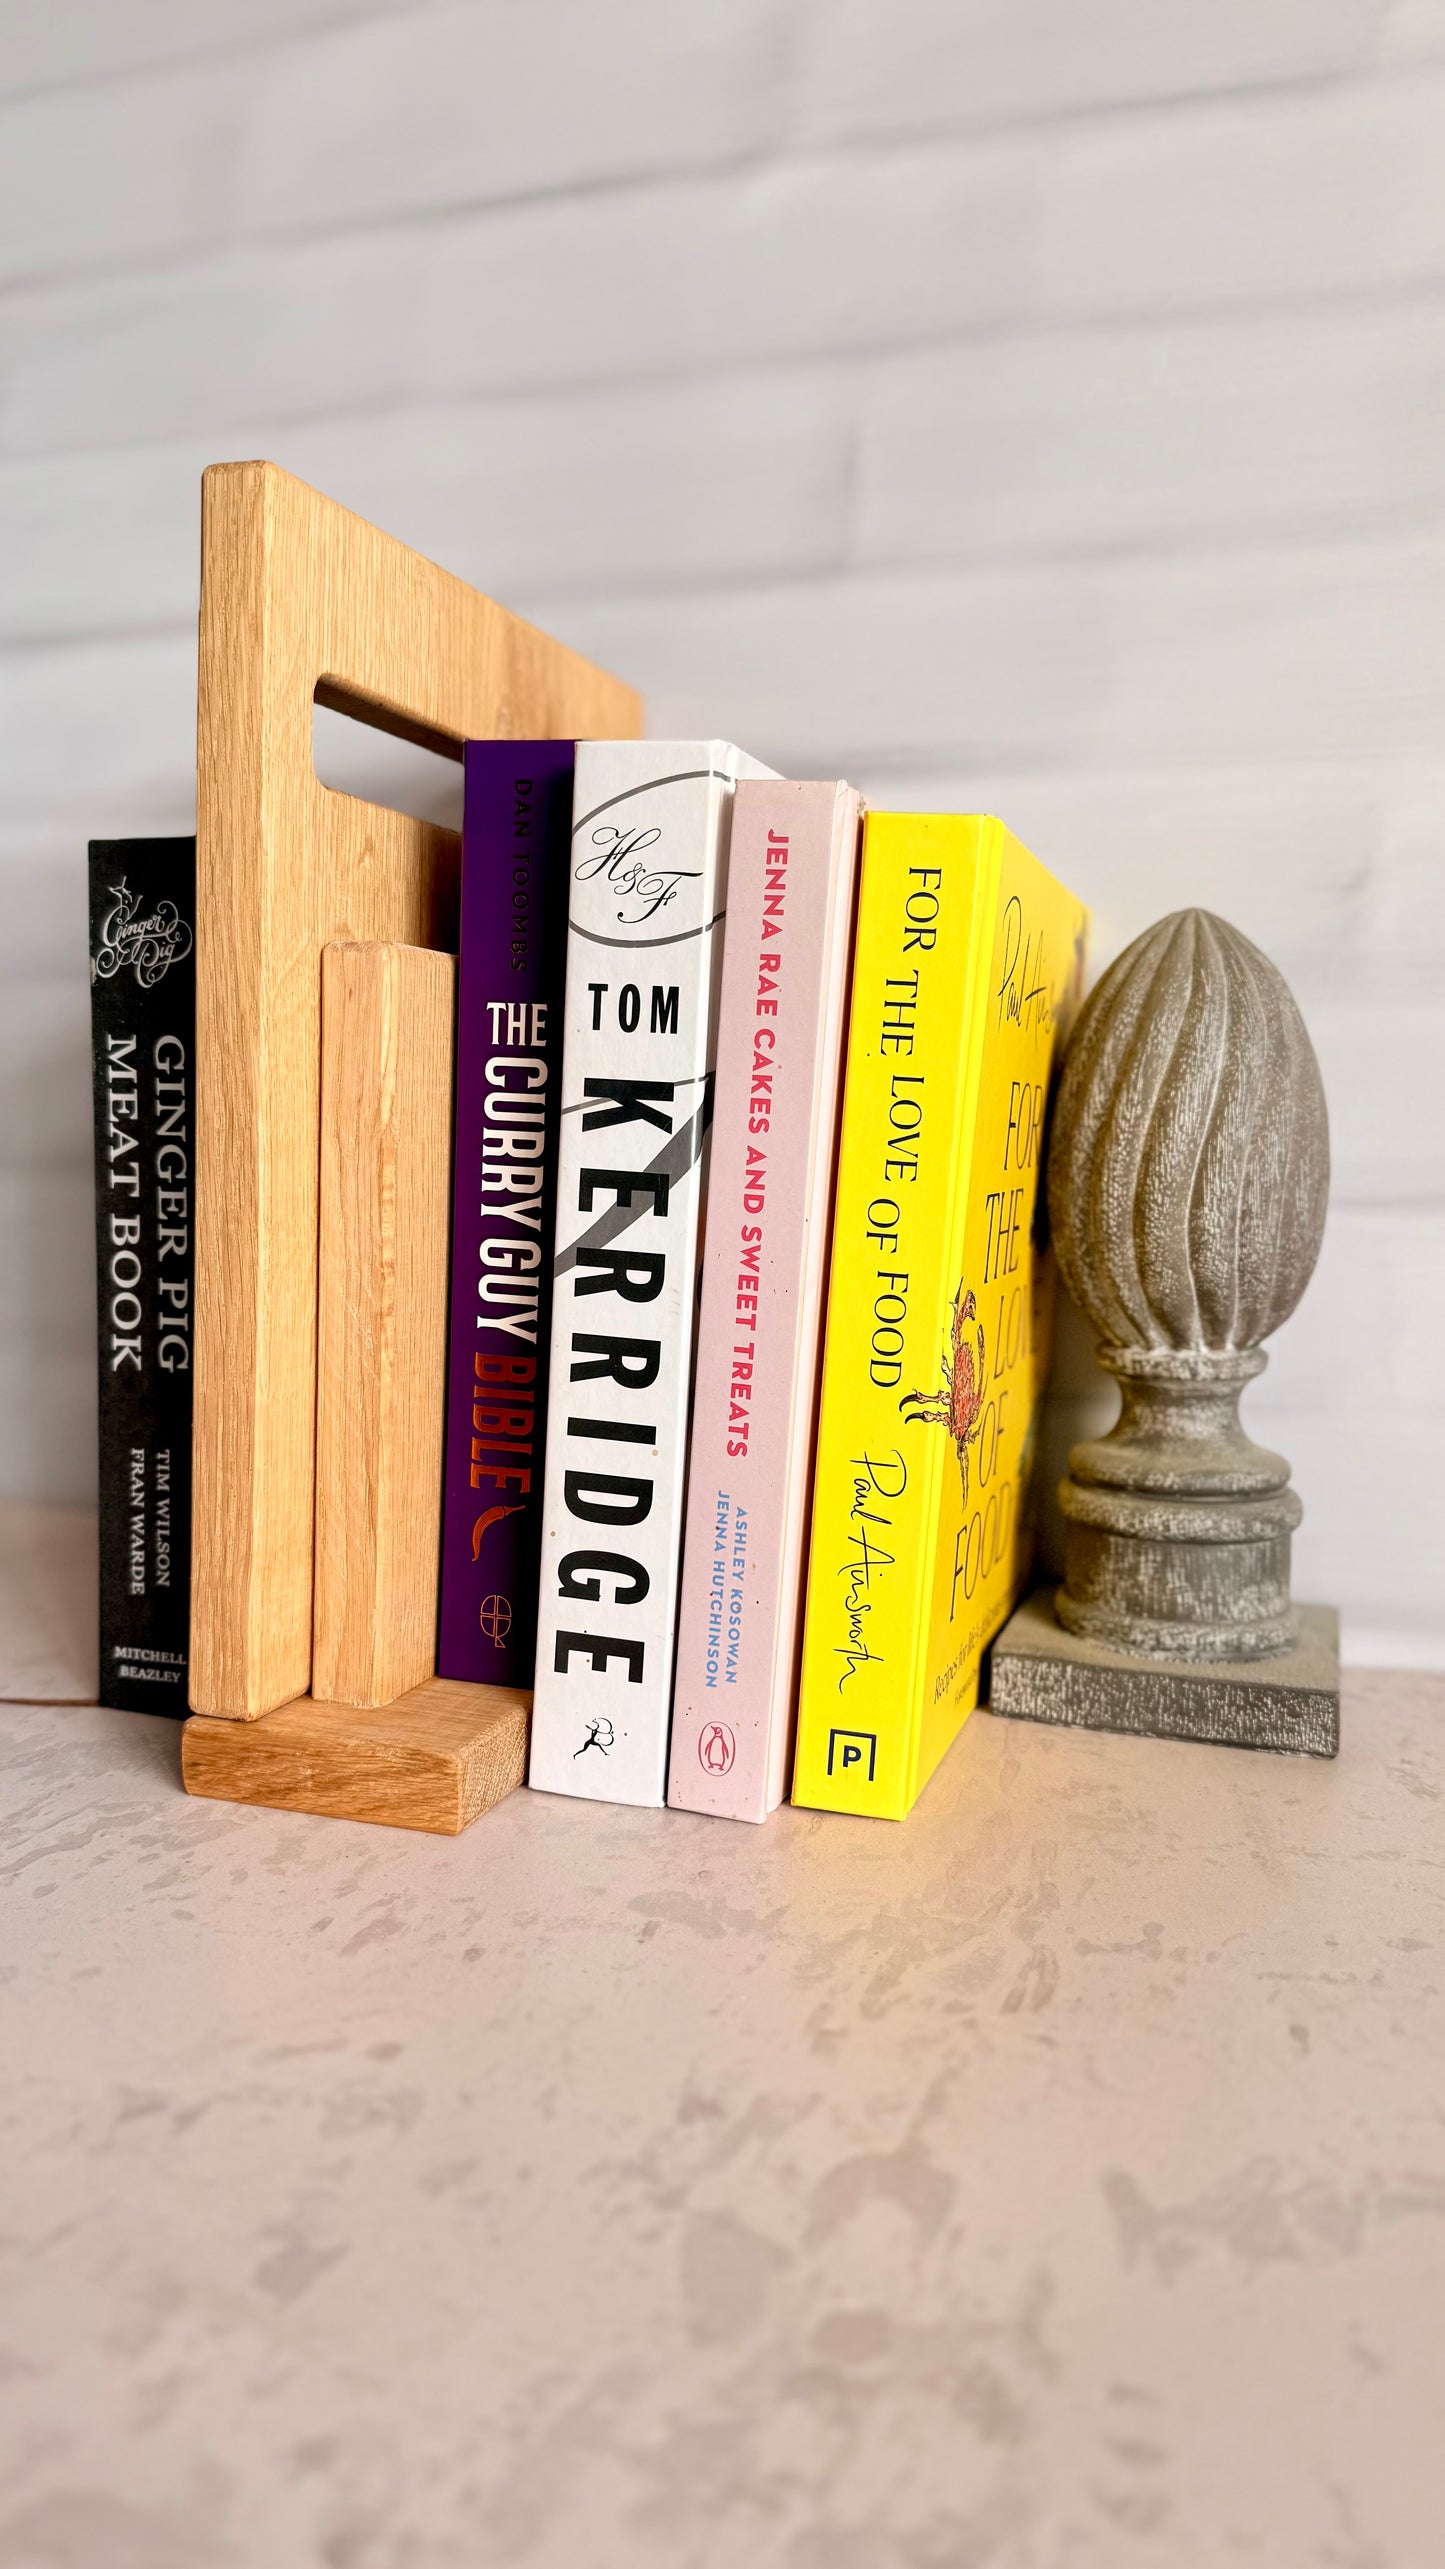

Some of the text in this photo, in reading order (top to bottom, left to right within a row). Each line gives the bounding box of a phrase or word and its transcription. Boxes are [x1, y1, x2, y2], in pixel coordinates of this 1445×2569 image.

[103, 904, 172, 948] Ginger
[509, 778, 533, 971] DAN TOOMBS
[575, 827, 703, 923] H&F
[487, 1002, 548, 1047] THE
[587, 983, 680, 1035] TOM
[998, 896, 1030, 1033] Paul
[726, 828, 789, 1458] JENNA RAE CAKES AND SWEET TREATS
[866, 866, 942, 1388] FOR THE LOVE OF FOOD
[1003, 1081, 1043, 1172] FOR
[107, 1033, 142, 1373] MEAT BOOK
[154, 1034, 190, 1374] GINGER PIG
[476, 1056, 548, 1345] CURRY GUY
[983, 1188, 1024, 1285] THE
[469, 1352, 537, 1495] BIBLE
[554, 1077, 676, 1685] KERRIDGE
[978, 1391, 1008, 1488] OF
[130, 1448, 146, 1596] FRAN WARDE
[155, 1448, 171, 1588] TIM WILSON
[848, 1449, 907, 1526] Paul
[950, 1481, 1012, 1623] FOOD
[113, 1645, 188, 1666] MITCHELL
[705, 1490, 731, 1689] JENNA HUTCHINSON
[724, 1506, 748, 1685] ASHLEY KOSOWAN
[119, 1664, 182, 1684] BEAZLEY
[843, 1744, 862, 1769] P
